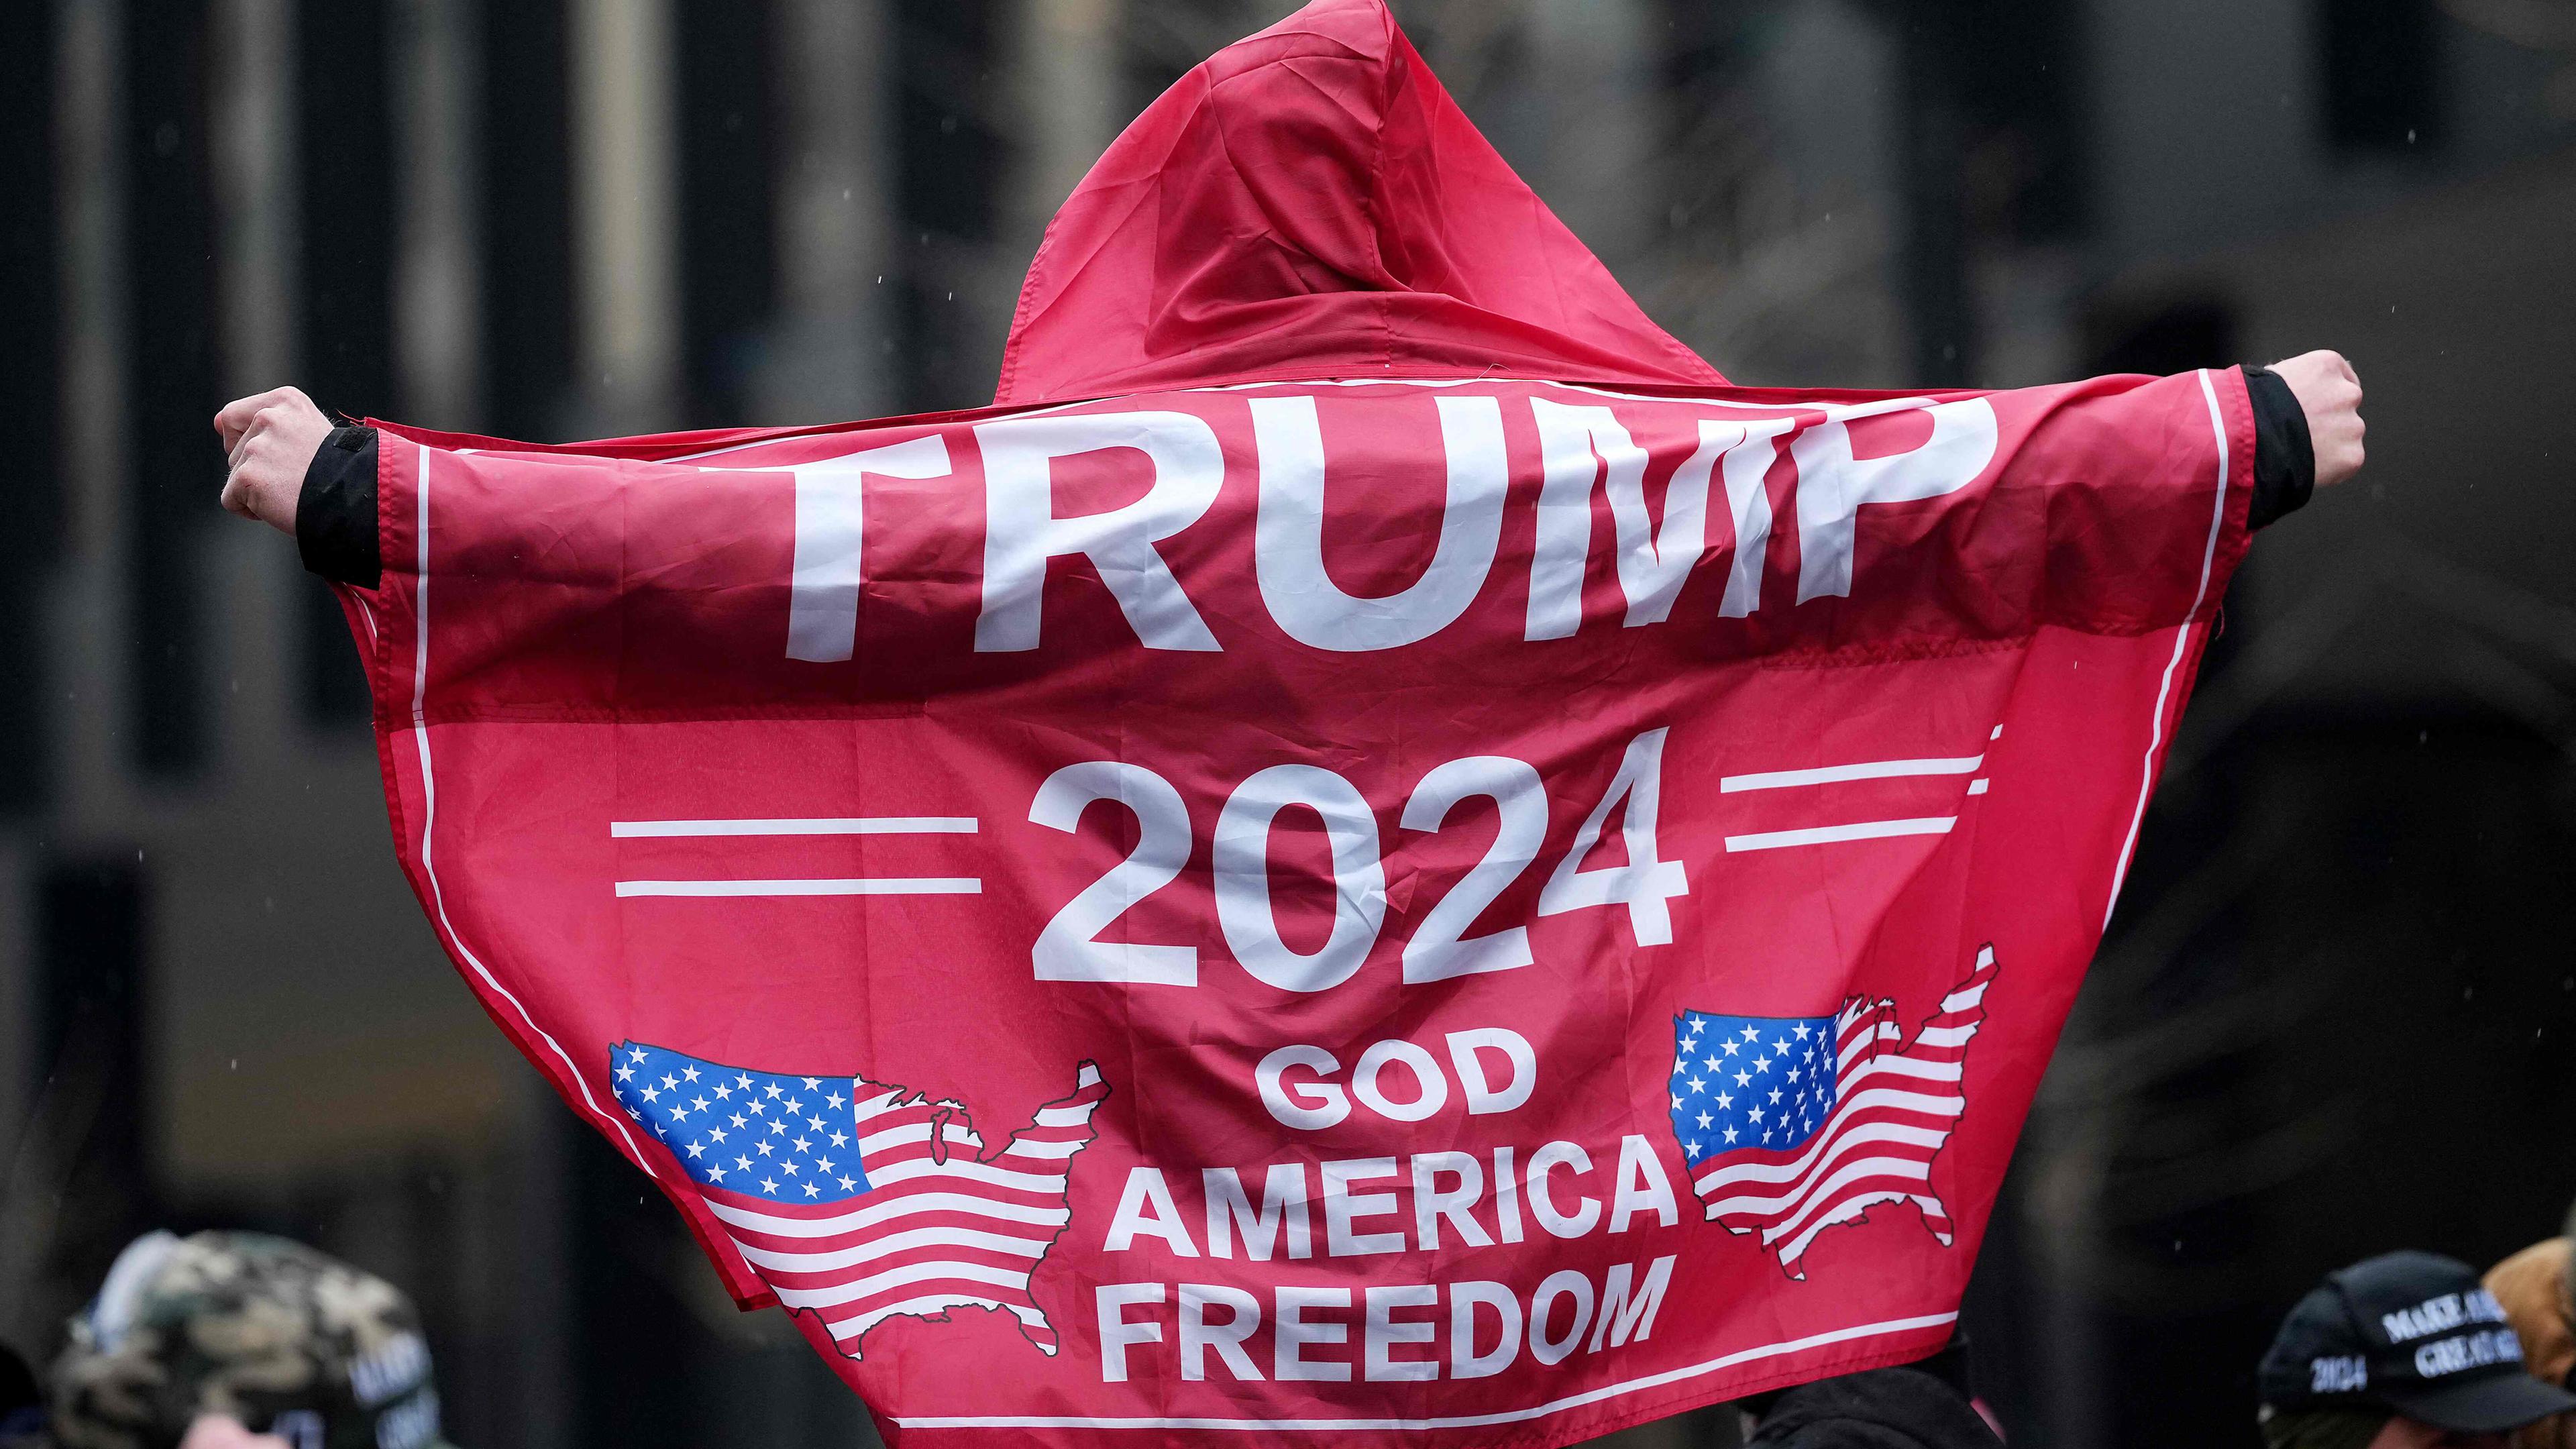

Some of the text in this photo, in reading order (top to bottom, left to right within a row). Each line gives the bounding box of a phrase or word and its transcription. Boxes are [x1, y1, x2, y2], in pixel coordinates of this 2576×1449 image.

[699, 396, 1998, 662] TRUMP
[1028, 727, 1689, 993] 2024
[1254, 1028, 1536, 1130] GOD
[1103, 1134, 1678, 1261] AMERICA
[1095, 1254, 1677, 1382] FREEDOM
[2311, 1355, 2368, 1393] 2024
[2382, 1293, 2467, 1344] MAKE
